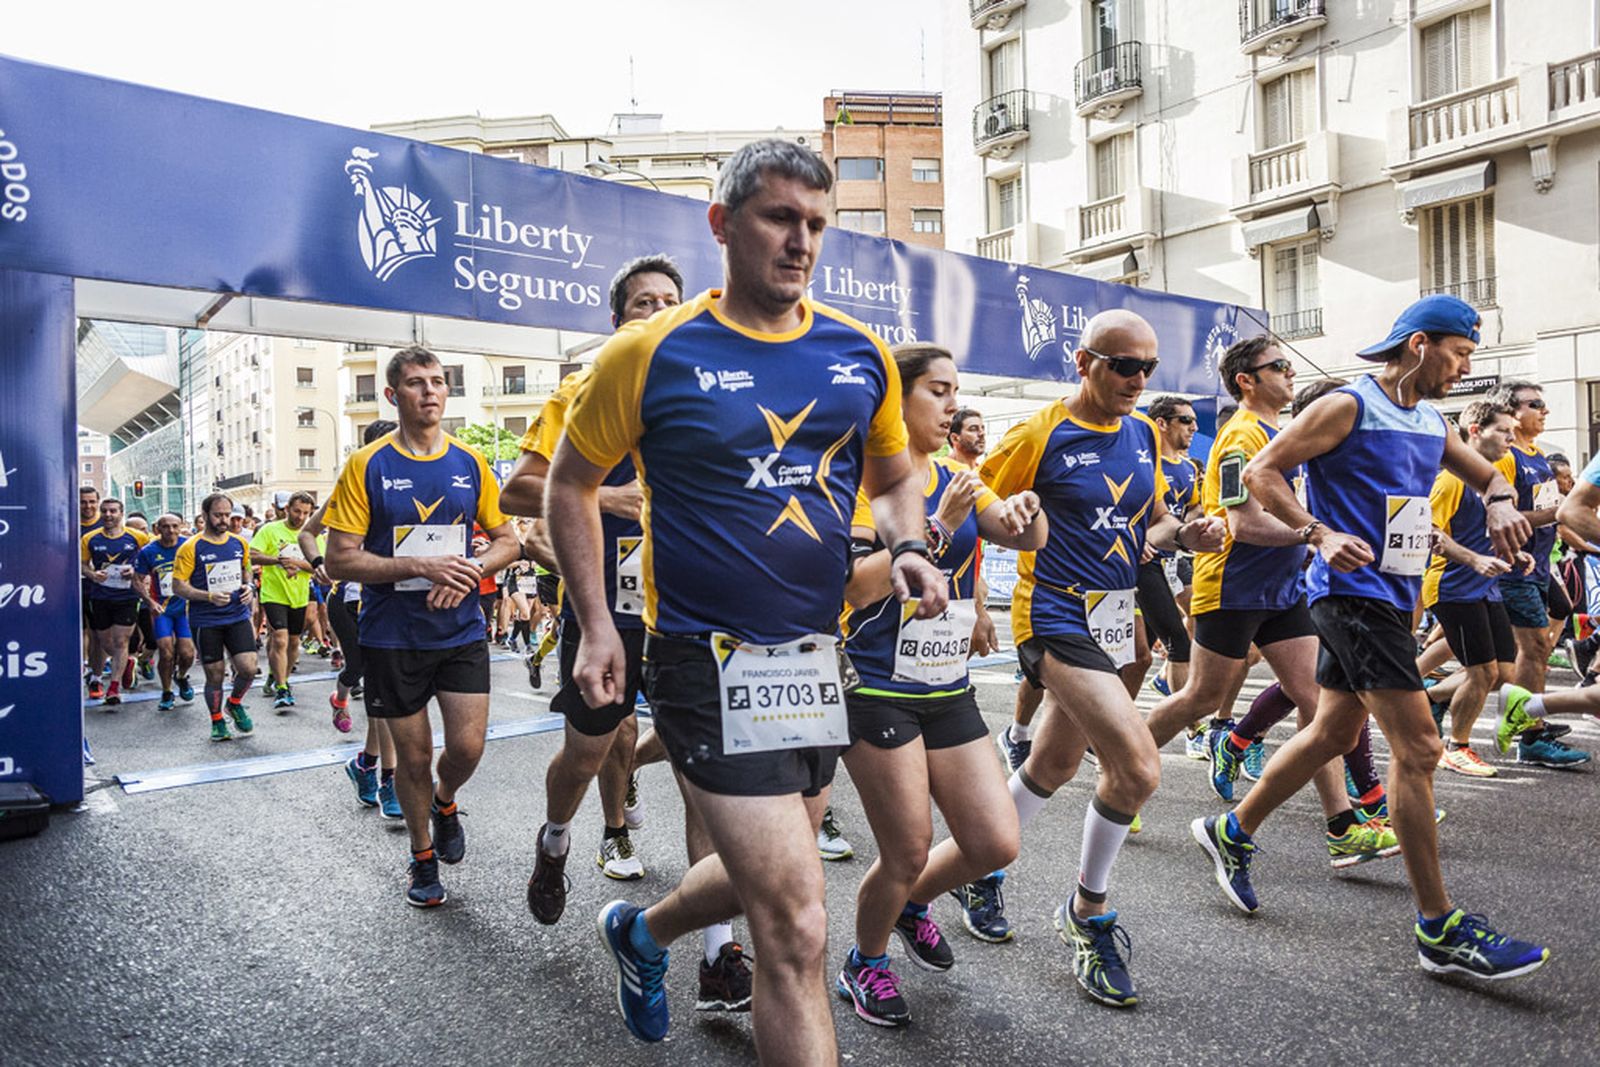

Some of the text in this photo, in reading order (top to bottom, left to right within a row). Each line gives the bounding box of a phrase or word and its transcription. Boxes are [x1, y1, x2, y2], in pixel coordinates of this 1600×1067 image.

[0, 128, 31, 222] ODOS
[453, 200, 594, 269] Liberty
[454, 255, 601, 311] Seguros
[822, 265, 912, 316] Liberty
[501, 463, 512, 478] P
[744, 452, 780, 489] X
[1090, 506, 1115, 530] X
[921, 640, 959, 657] 6043
[1105, 628, 1125, 644] 60
[0, 640, 49, 678] is
[741, 668, 821, 679] FRANCISCO JAVIER
[756, 683, 816, 709] 3703
